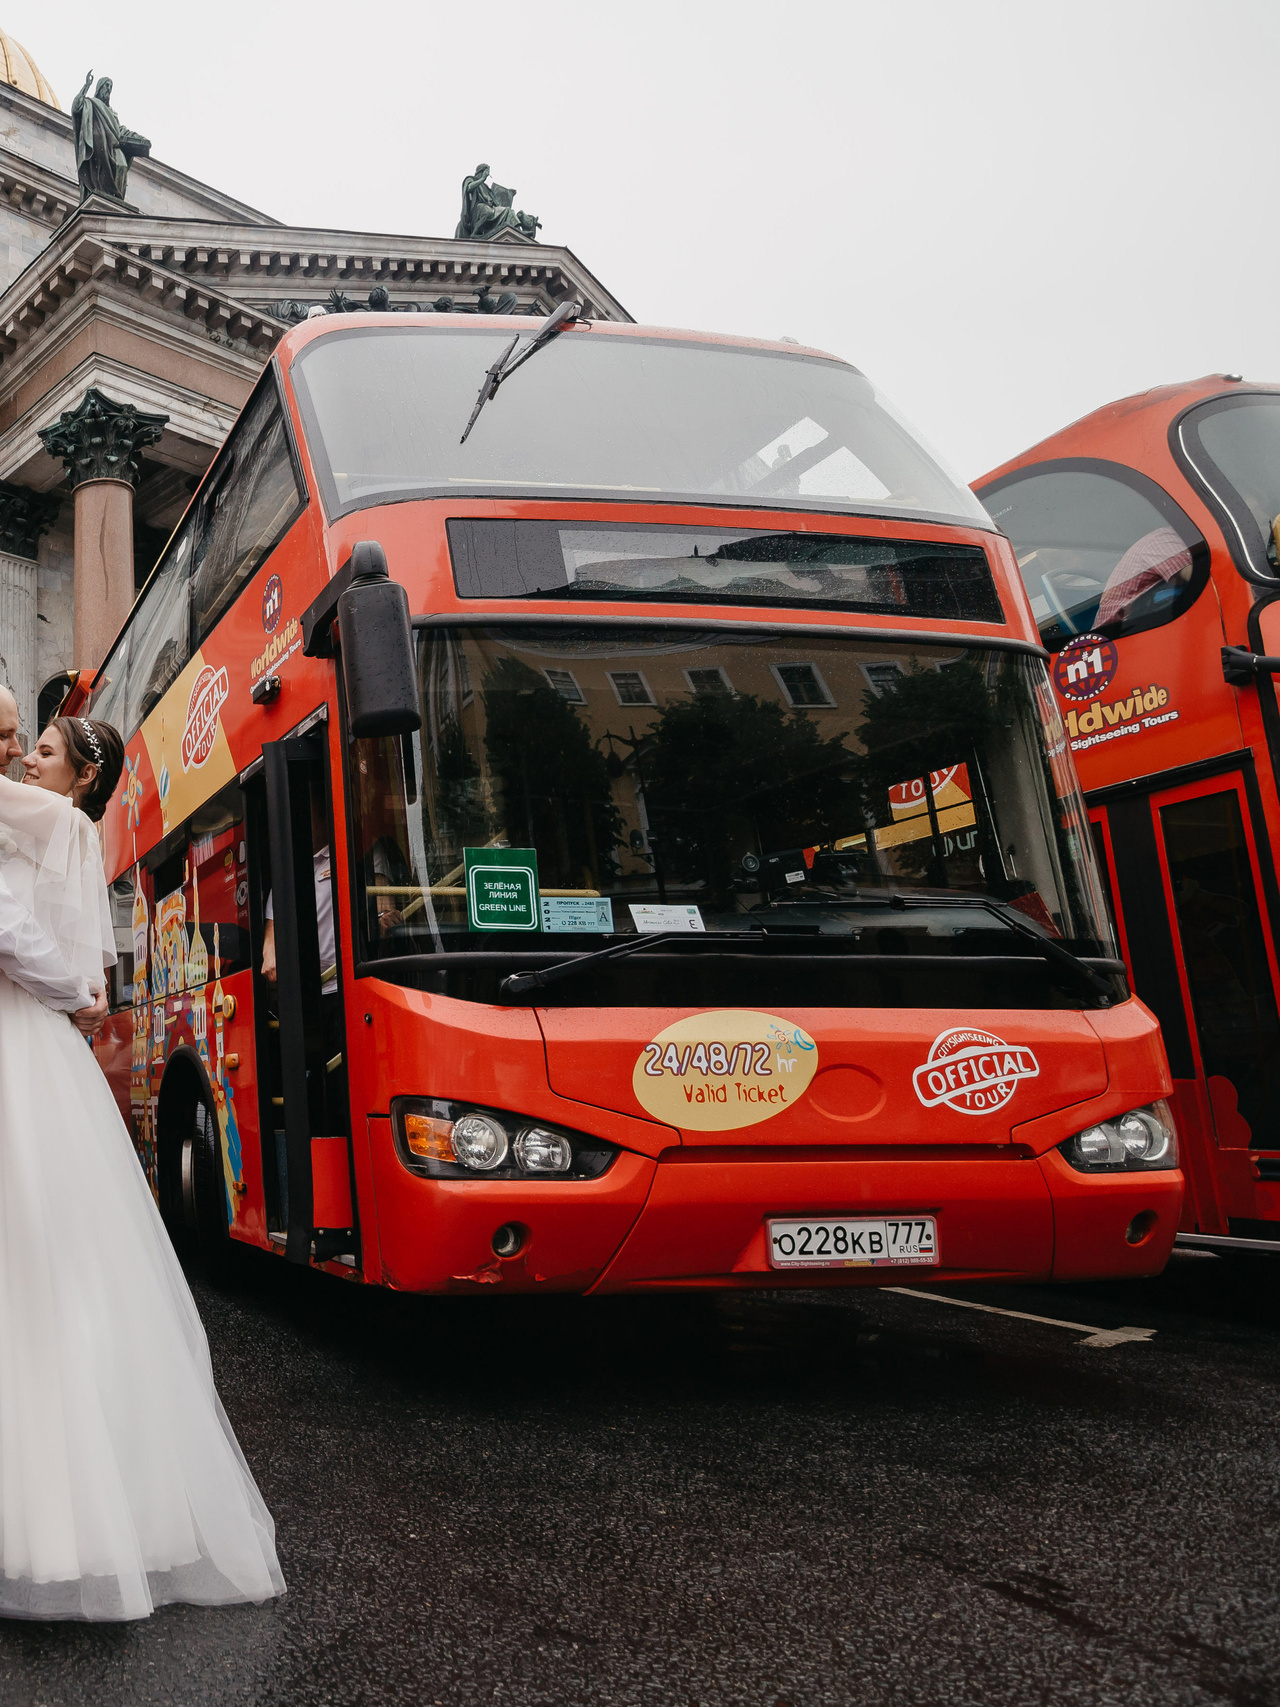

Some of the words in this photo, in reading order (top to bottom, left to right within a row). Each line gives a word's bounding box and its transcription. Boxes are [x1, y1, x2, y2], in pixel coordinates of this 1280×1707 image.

[251, 617, 298, 680] Worldwide
[1065, 681, 1108, 701] Operator
[186, 677, 225, 757] OFFICIAL
[199, 720, 216, 759] TOUR
[1070, 723, 1140, 750] Sightseeing
[1142, 711, 1178, 728] Tours
[483, 882, 522, 890] ЗЕЛЁНАЯ
[489, 891, 518, 899] ЛИНИЯ
[509, 904, 527, 912] LINE
[937, 1032, 999, 1058] CITYSIGHTSEEING
[644, 1042, 773, 1076] 24/48/72
[777, 1053, 797, 1073] hr
[928, 1052, 1031, 1095] OFFICIAL
[683, 1083, 728, 1103] Valid
[735, 1082, 788, 1103] Ticket
[965, 1082, 1011, 1107] TOUR
[888, 1222, 926, 1245] 777
[900, 1245, 919, 1254] RUS
